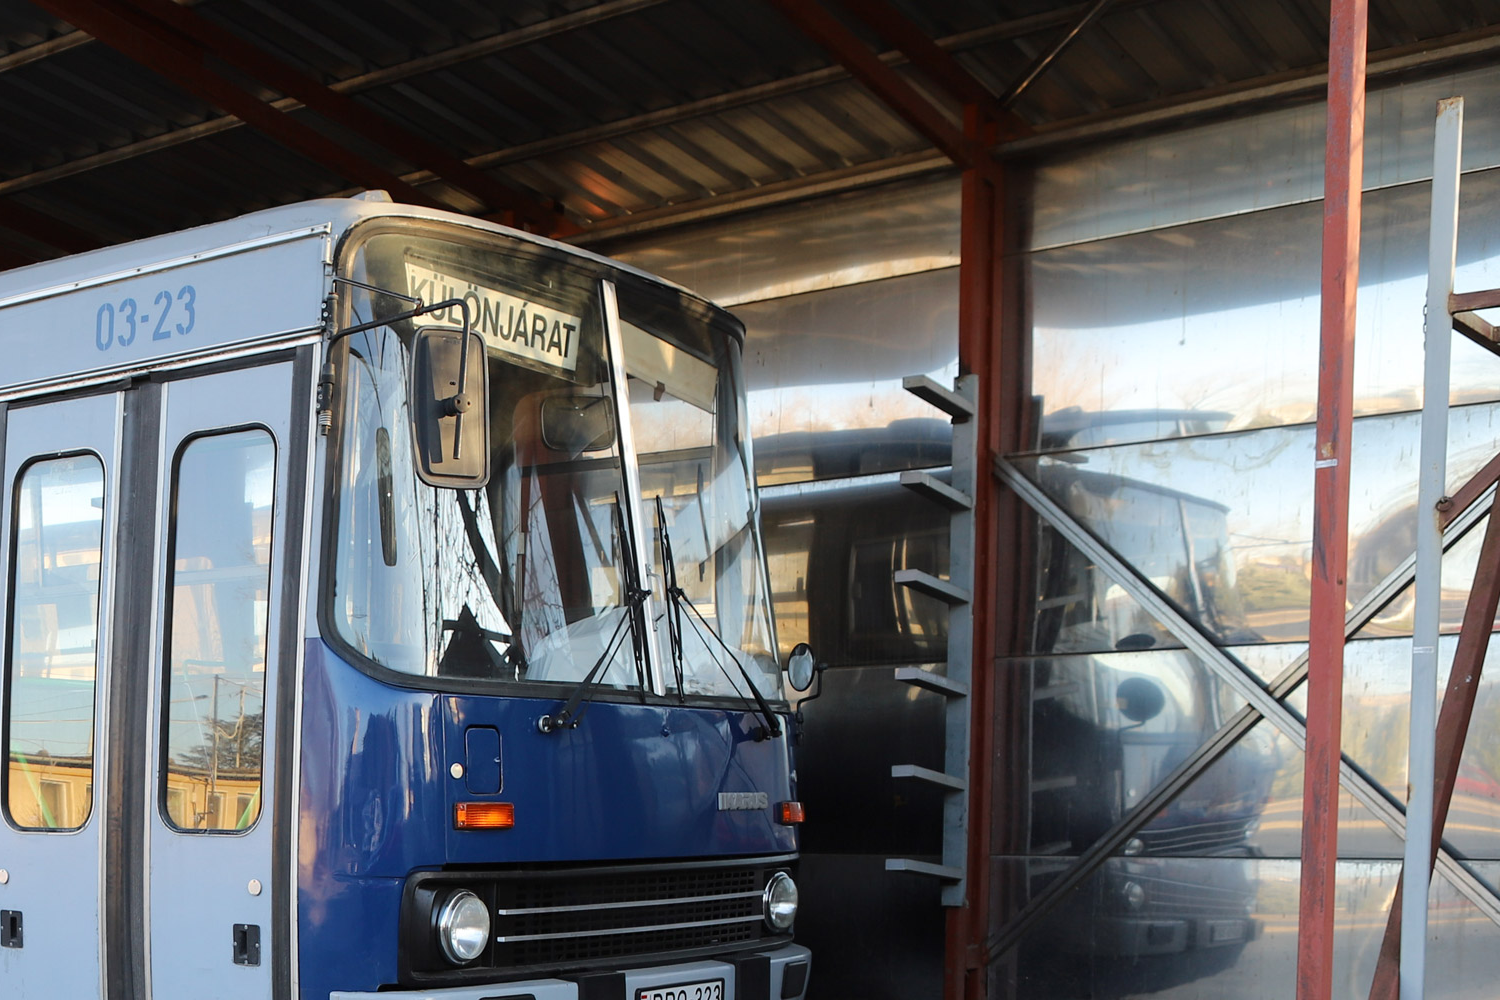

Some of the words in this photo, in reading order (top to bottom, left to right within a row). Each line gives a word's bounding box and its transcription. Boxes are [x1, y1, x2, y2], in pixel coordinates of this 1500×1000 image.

[95, 284, 197, 352] 03-23
[410, 272, 576, 359] KÜLÖNJÁRAT
[718, 792, 768, 810] IKARUS
